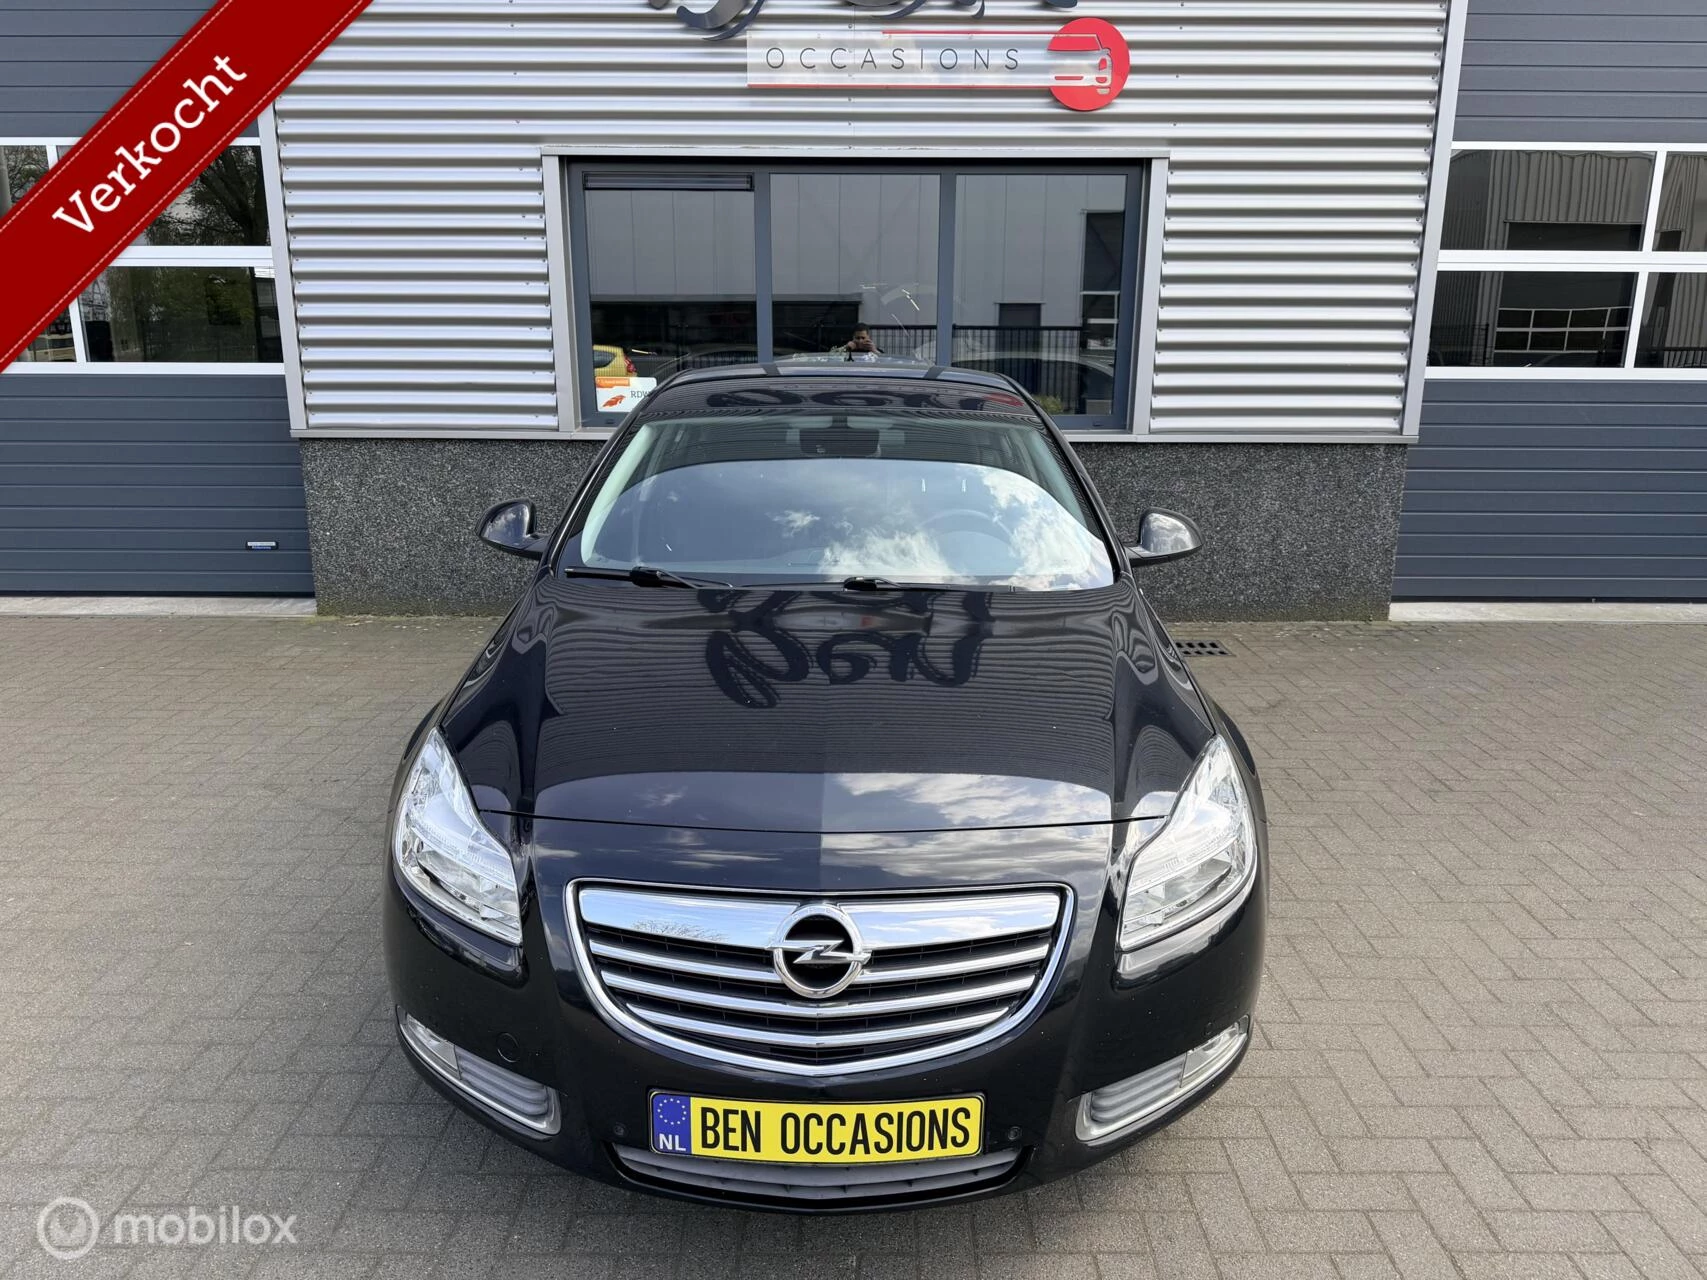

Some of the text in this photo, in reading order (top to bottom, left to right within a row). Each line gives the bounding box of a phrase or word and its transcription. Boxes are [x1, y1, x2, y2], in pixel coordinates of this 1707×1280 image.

[765, 46, 1019, 70] OCCASIONS
[658, 1133, 687, 1152] NL
[700, 1106, 971, 1156] BEN OCCASIONS
